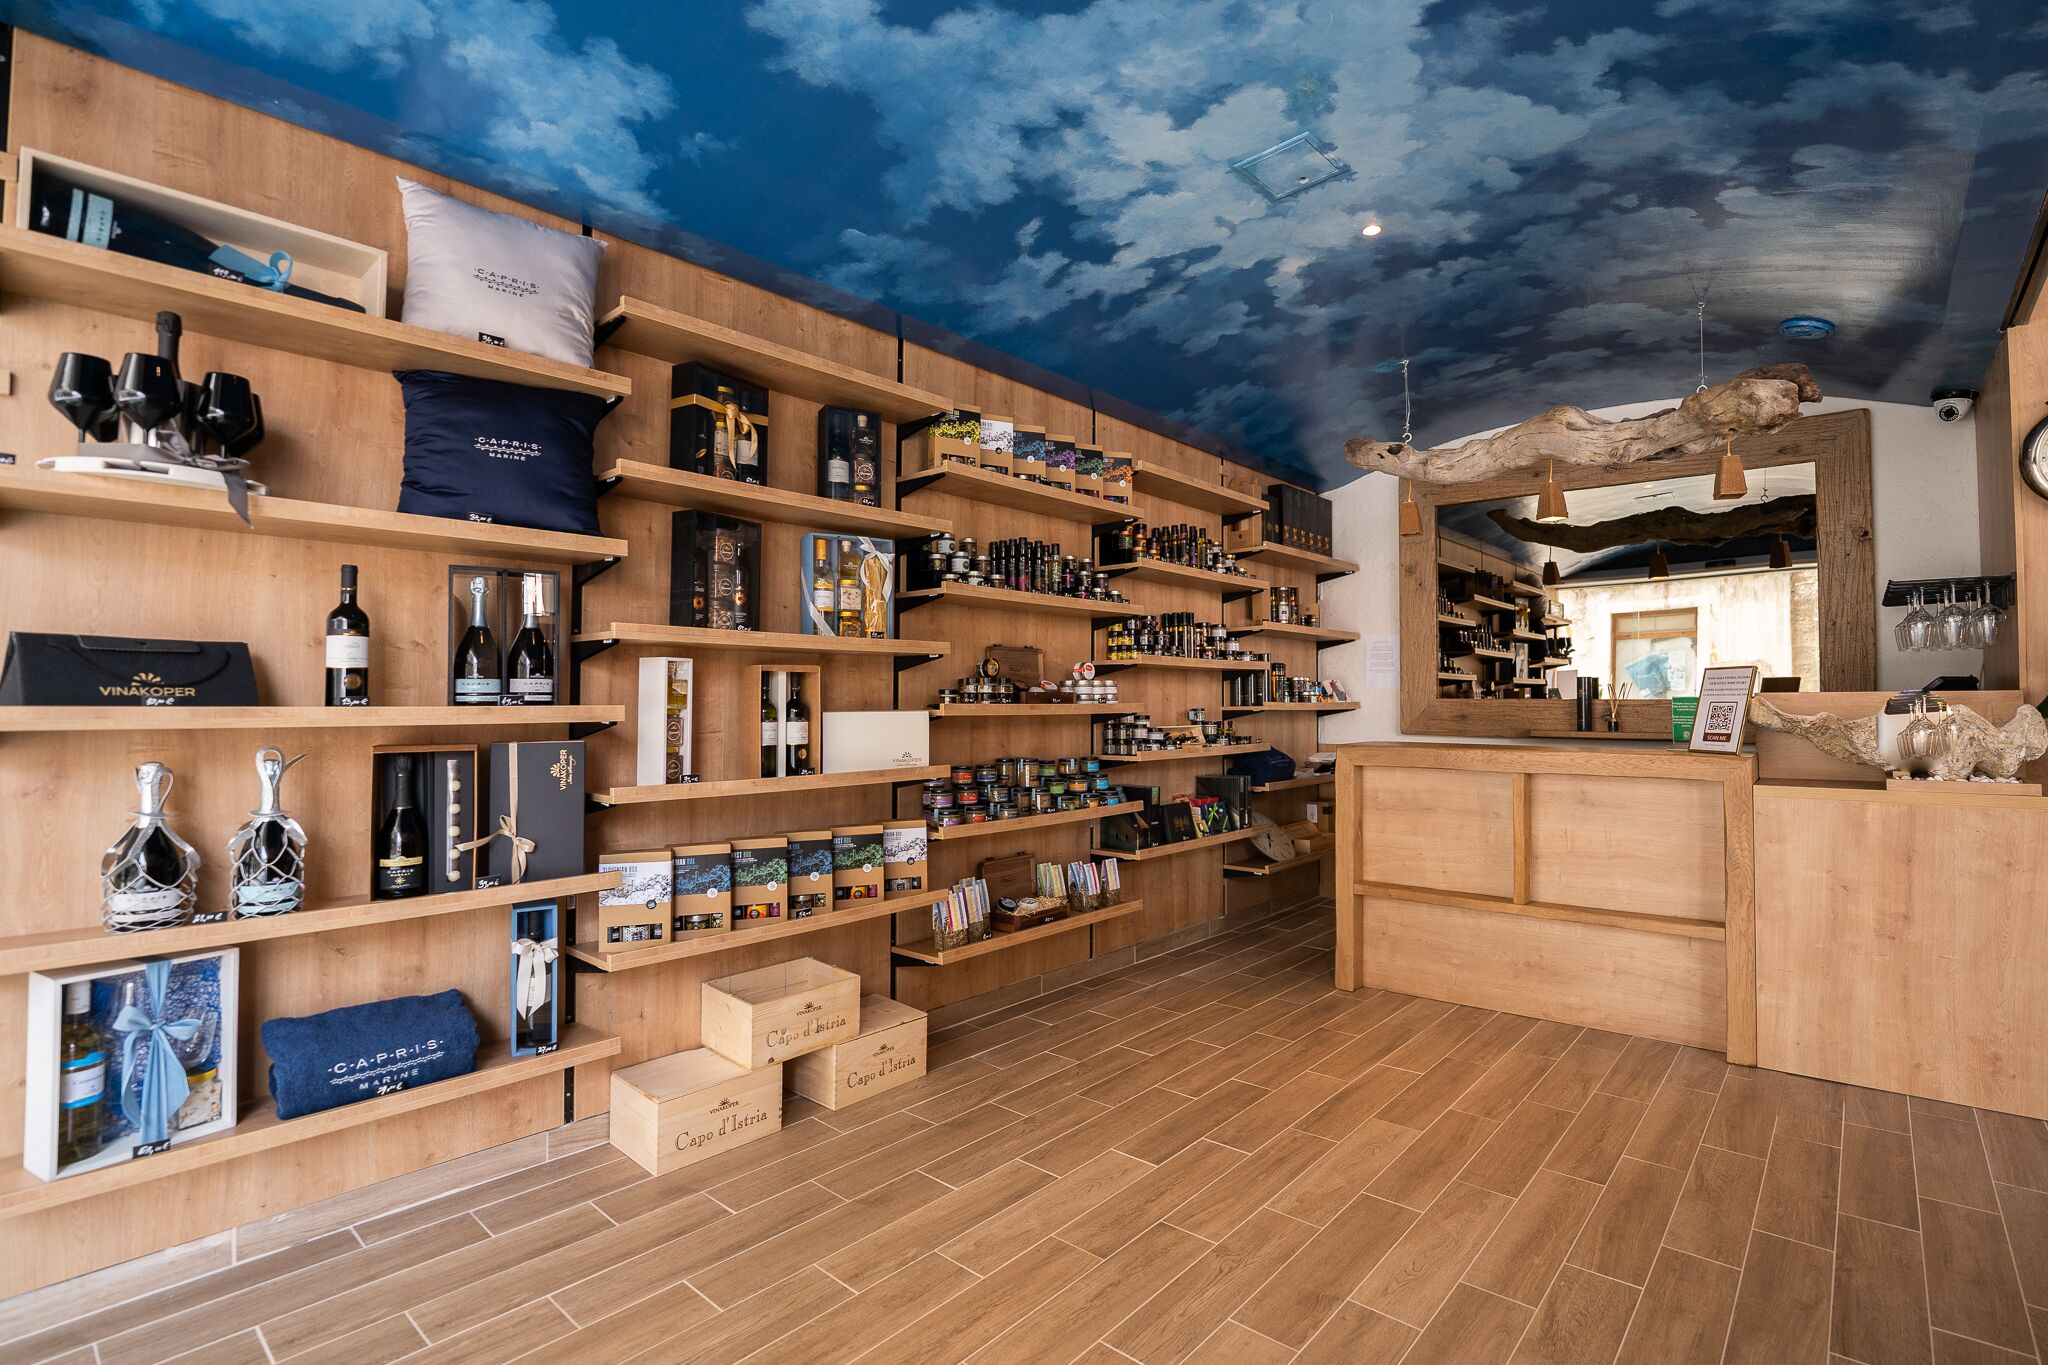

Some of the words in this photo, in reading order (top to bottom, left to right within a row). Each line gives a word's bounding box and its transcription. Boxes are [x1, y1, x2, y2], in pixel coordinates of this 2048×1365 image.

[488, 285, 525, 298] MARINE
[489, 452, 526, 461] MARINE
[99, 687, 196, 696] VINAKOPER
[767, 1029, 799, 1047] Capo
[803, 1015, 846, 1037] d'Istria
[359, 1068, 419, 1090] MARINE
[847, 1071, 876, 1088] Capo
[879, 1054, 916, 1077] d'Istria
[710, 1101, 740, 1114] VINAKOPER
[675, 1131, 714, 1151] Capo
[718, 1108, 768, 1136] d'Istria
